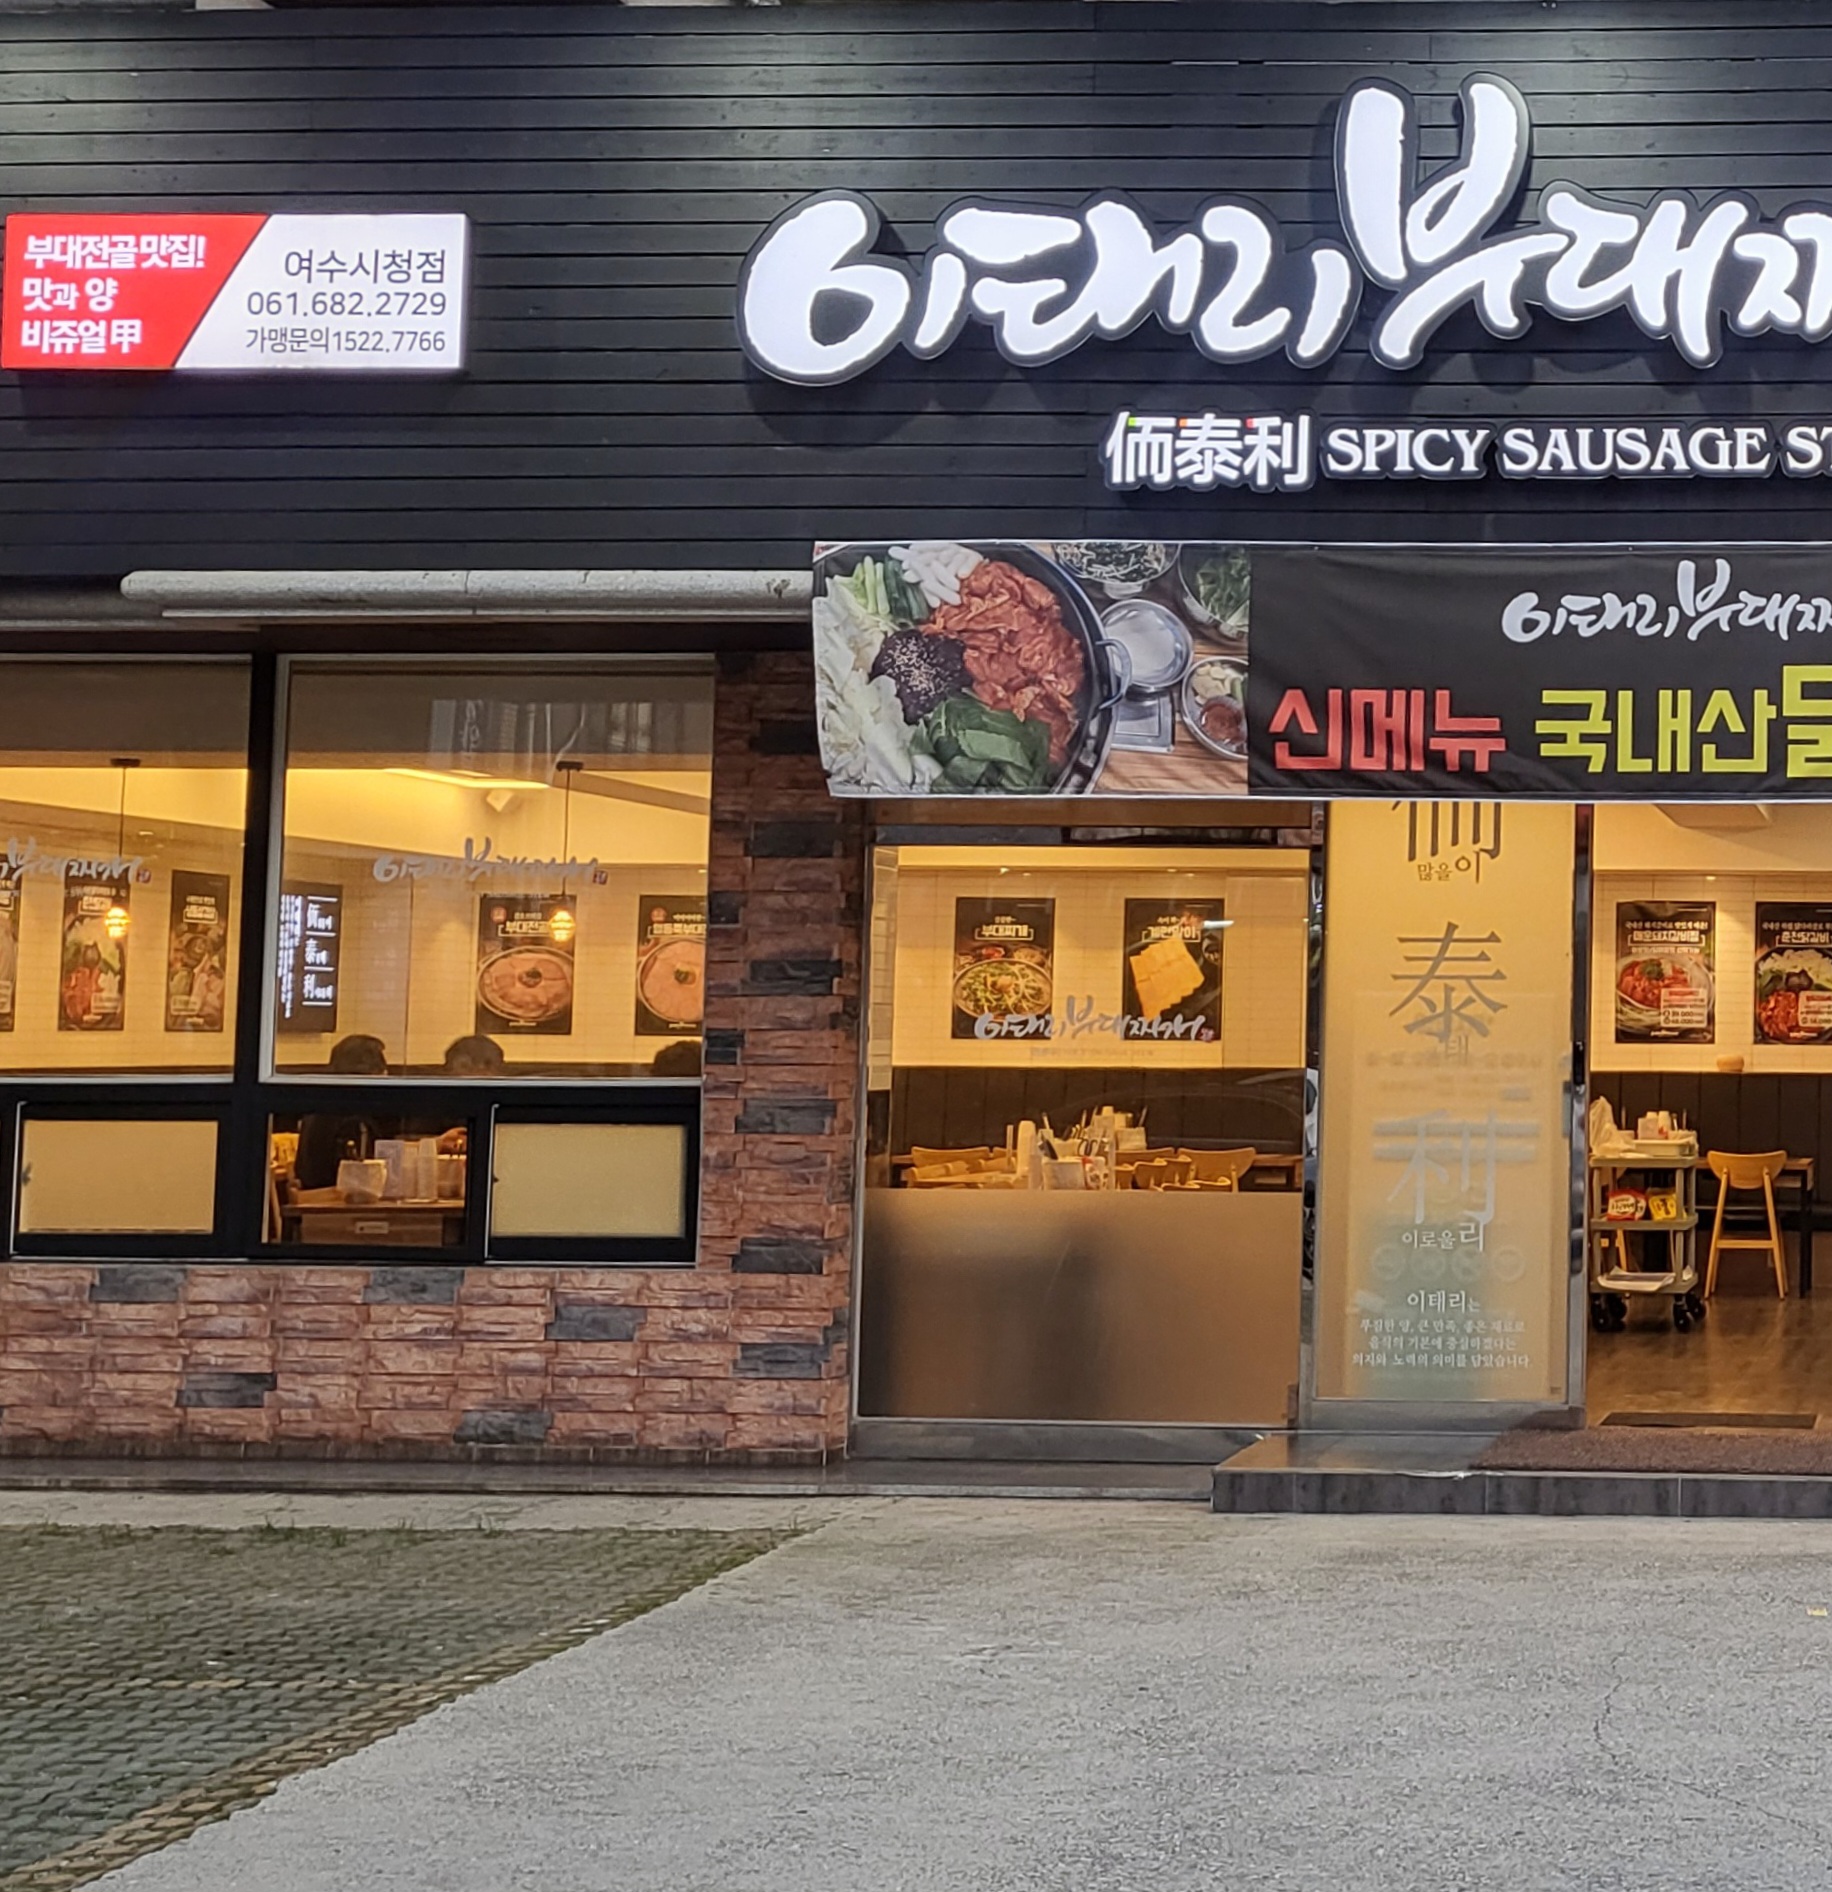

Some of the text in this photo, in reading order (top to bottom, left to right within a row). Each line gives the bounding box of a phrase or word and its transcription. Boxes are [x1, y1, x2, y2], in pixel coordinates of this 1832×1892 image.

[24, 235, 205, 269] 부대전골 맛집!
[284, 249, 446, 284] 여수시청점
[88, 276, 118, 312] 양
[247, 292, 446, 318] 061.682.2729
[21, 319, 141, 354] 비쥬얼 甲
[1326, 427, 1489, 473] SPICY
[1502, 425, 1770, 473] SAUSAGE
[1268, 688, 1507, 772] 신메뉴
[1534, 688, 1777, 773] 국내산
[1389, 921, 1508, 1043] 泰
[1402, 1229, 1456, 1250] 이로울
[1407, 1289, 1481, 1314] 이태리는
